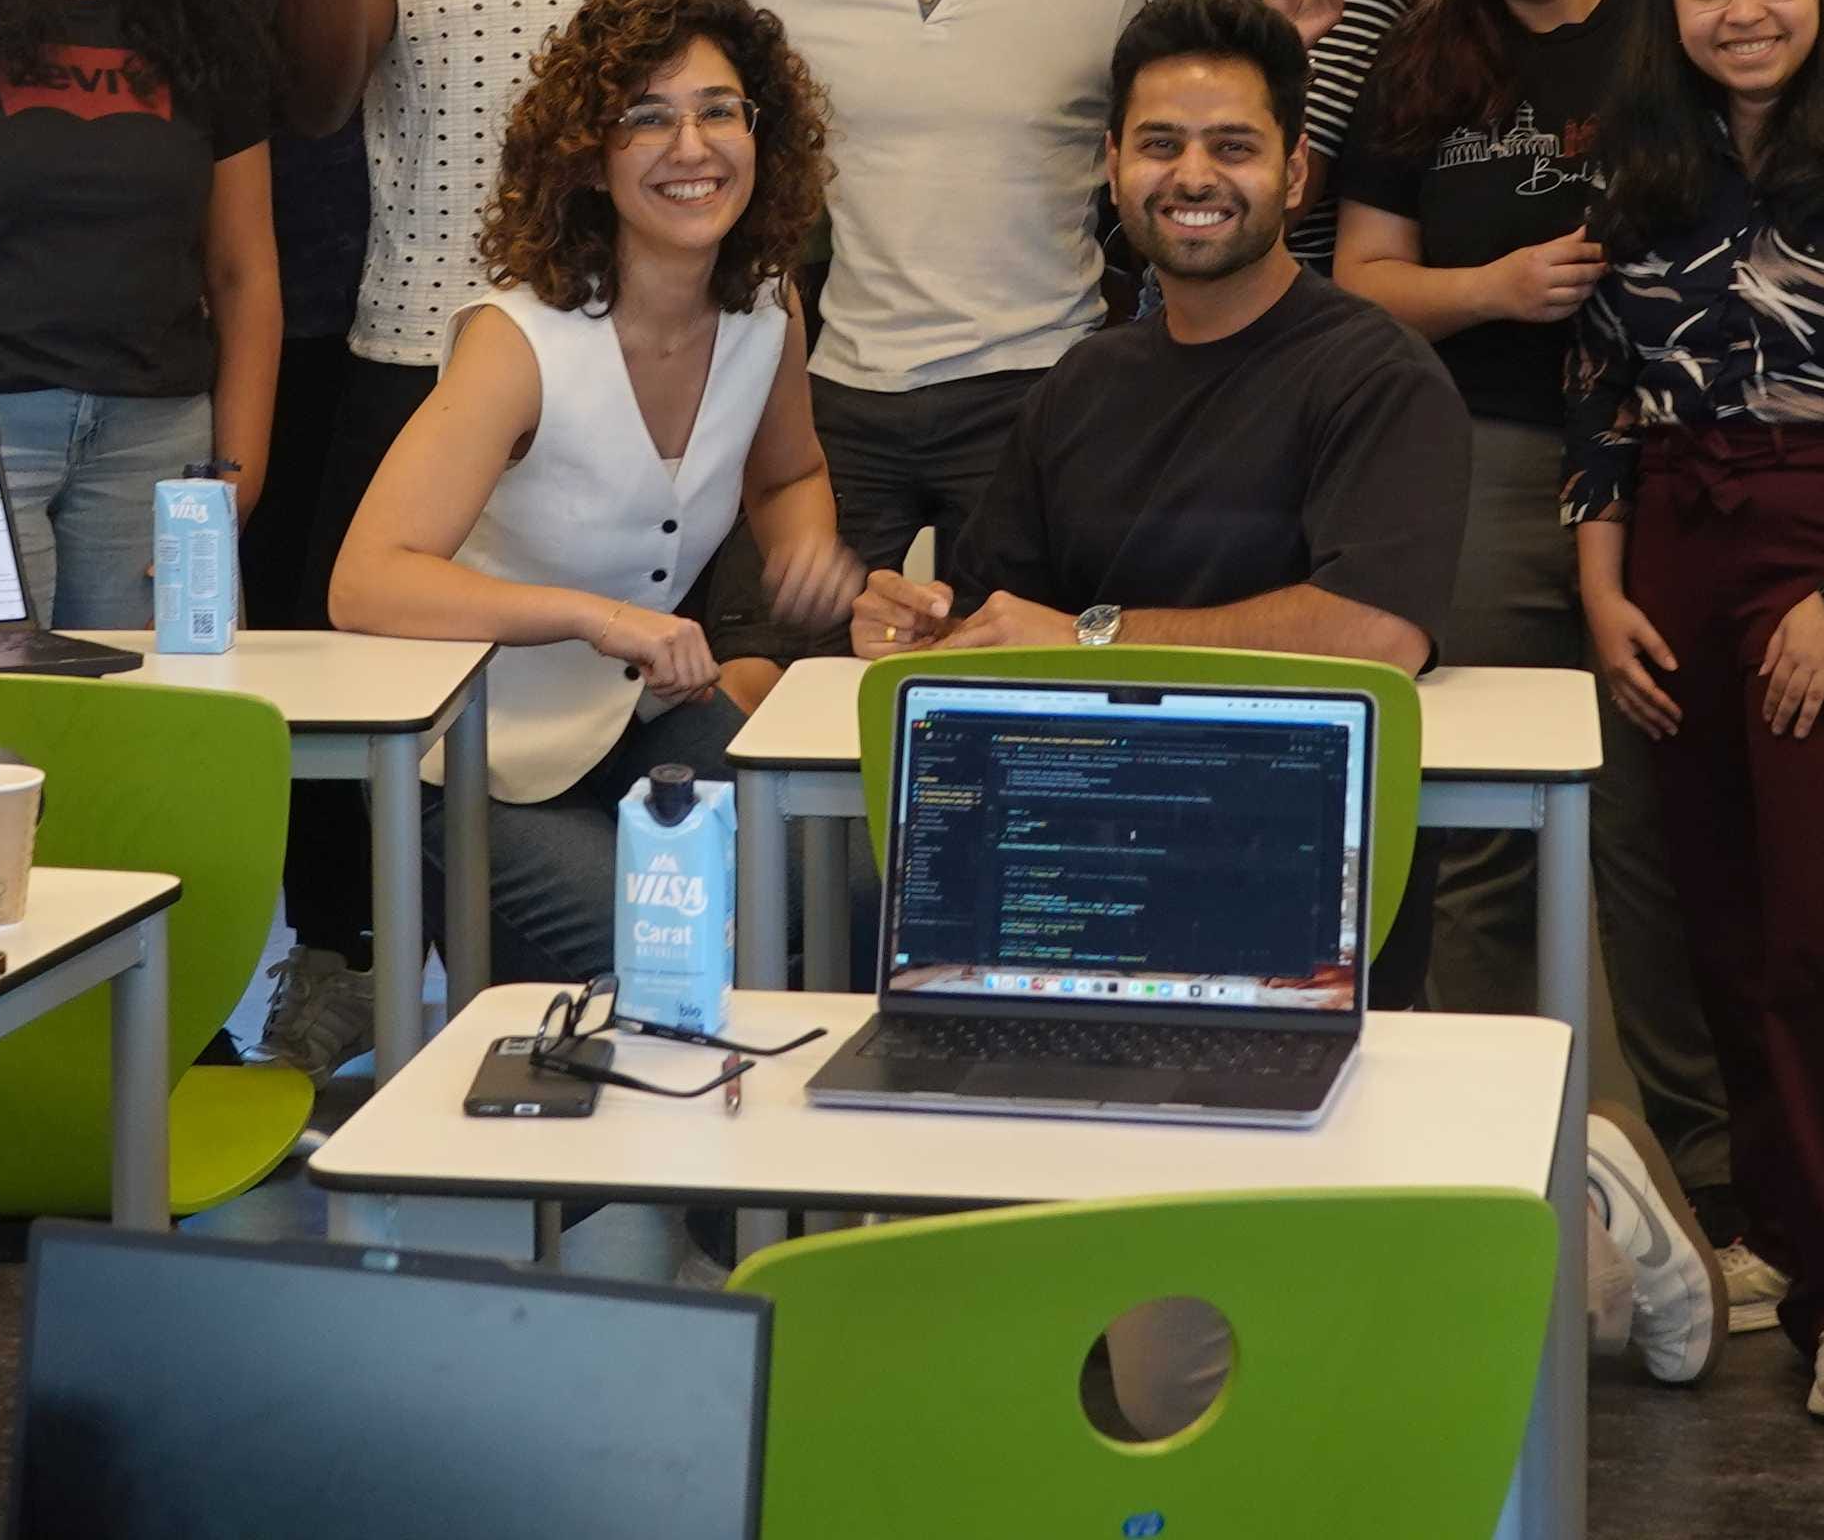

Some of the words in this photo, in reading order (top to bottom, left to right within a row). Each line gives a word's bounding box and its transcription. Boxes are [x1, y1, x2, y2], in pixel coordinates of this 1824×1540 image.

[1514, 157, 1602, 196] Berl
[626, 872, 708, 917] VILSA
[634, 919, 693, 945] Carat
